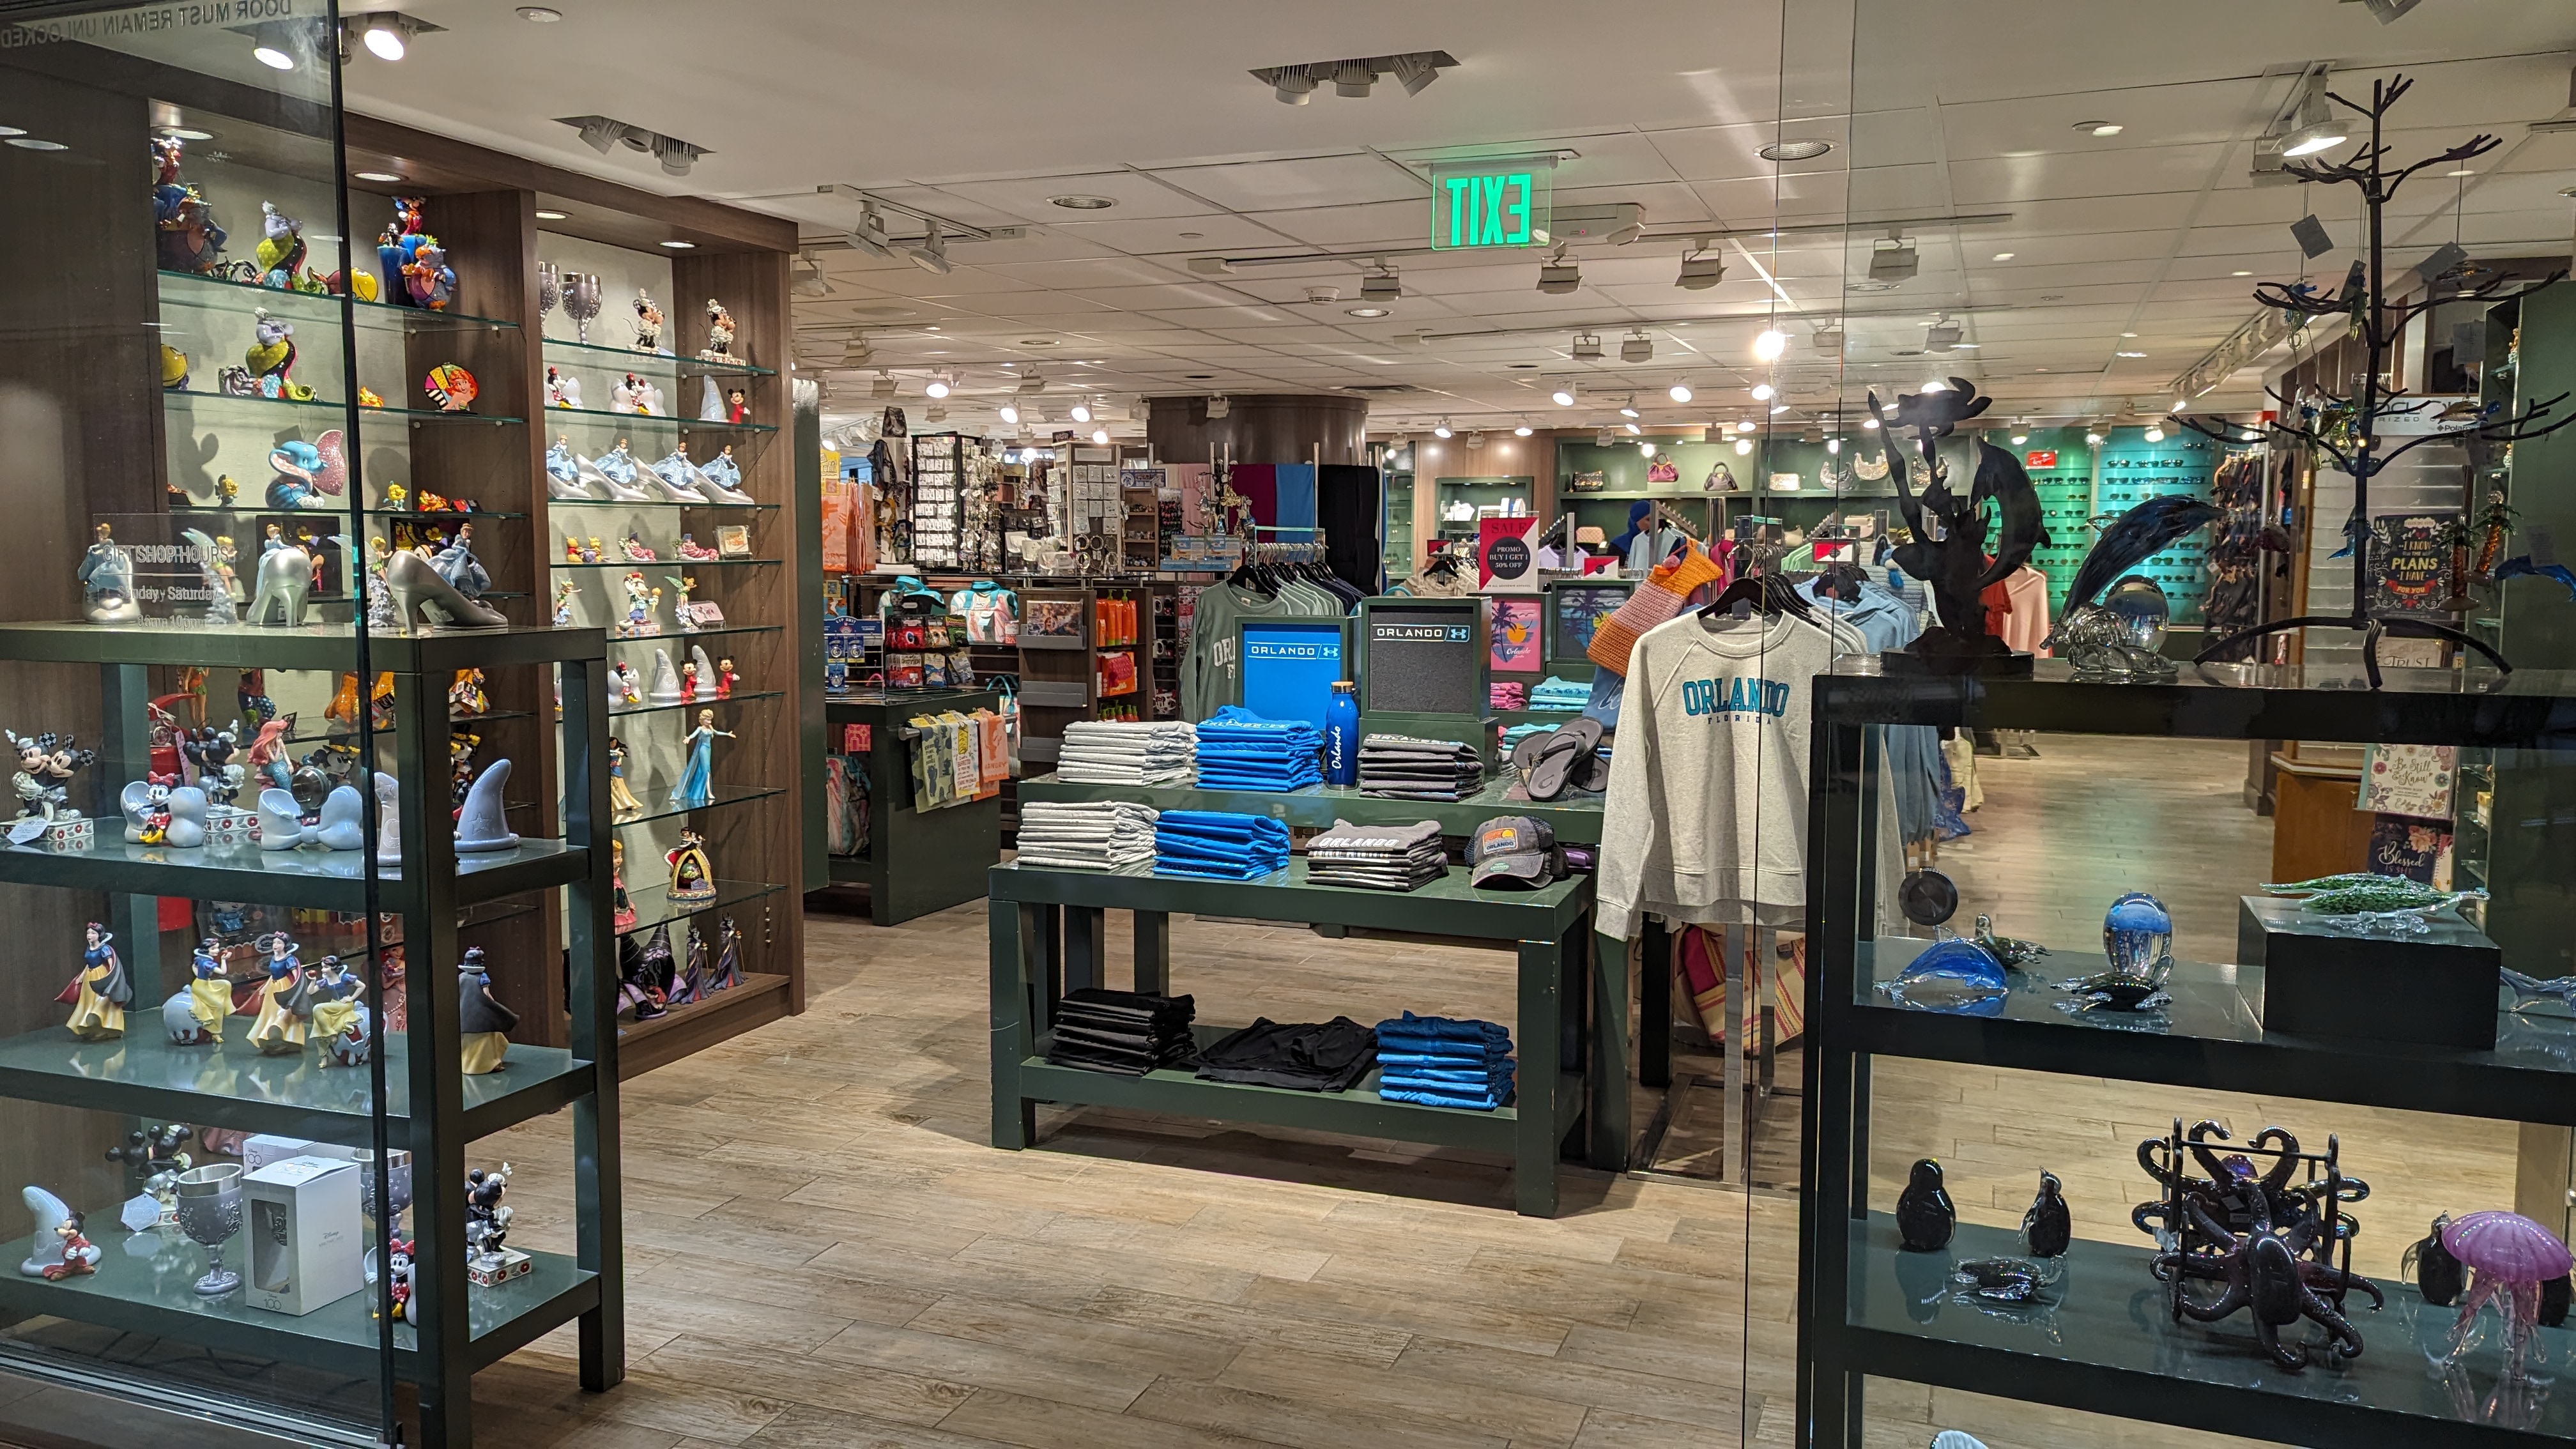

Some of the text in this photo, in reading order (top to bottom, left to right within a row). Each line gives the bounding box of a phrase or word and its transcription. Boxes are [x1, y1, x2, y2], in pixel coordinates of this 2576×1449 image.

[1491, 523, 1528, 533] SALE
[2409, 540, 2432, 551] KNOW
[102, 544, 229, 564] GIFT SHOP HOURS
[2391, 557, 2439, 571] PLANS
[2405, 571, 2426, 581] HAVE
[167, 586, 218, 604] Saturday
[1377, 627, 1443, 638] ORLANDO
[1251, 645, 1315, 656] ORLANDO
[1682, 677, 1790, 717] ORLANDO
[1707, 714, 1772, 725] FLORIDA
[1330, 726, 1342, 769] Orlando
[2392, 756, 2432, 773] Be Still
[2398, 771, 2428, 786] Know
[1319, 837, 1400, 848] ORLANDO
[1486, 841, 1514, 850] ORLANDO
[2377, 841, 2425, 867] Blessed
[245, 1153, 262, 1165] 100
[264, 1298, 282, 1310] 100
